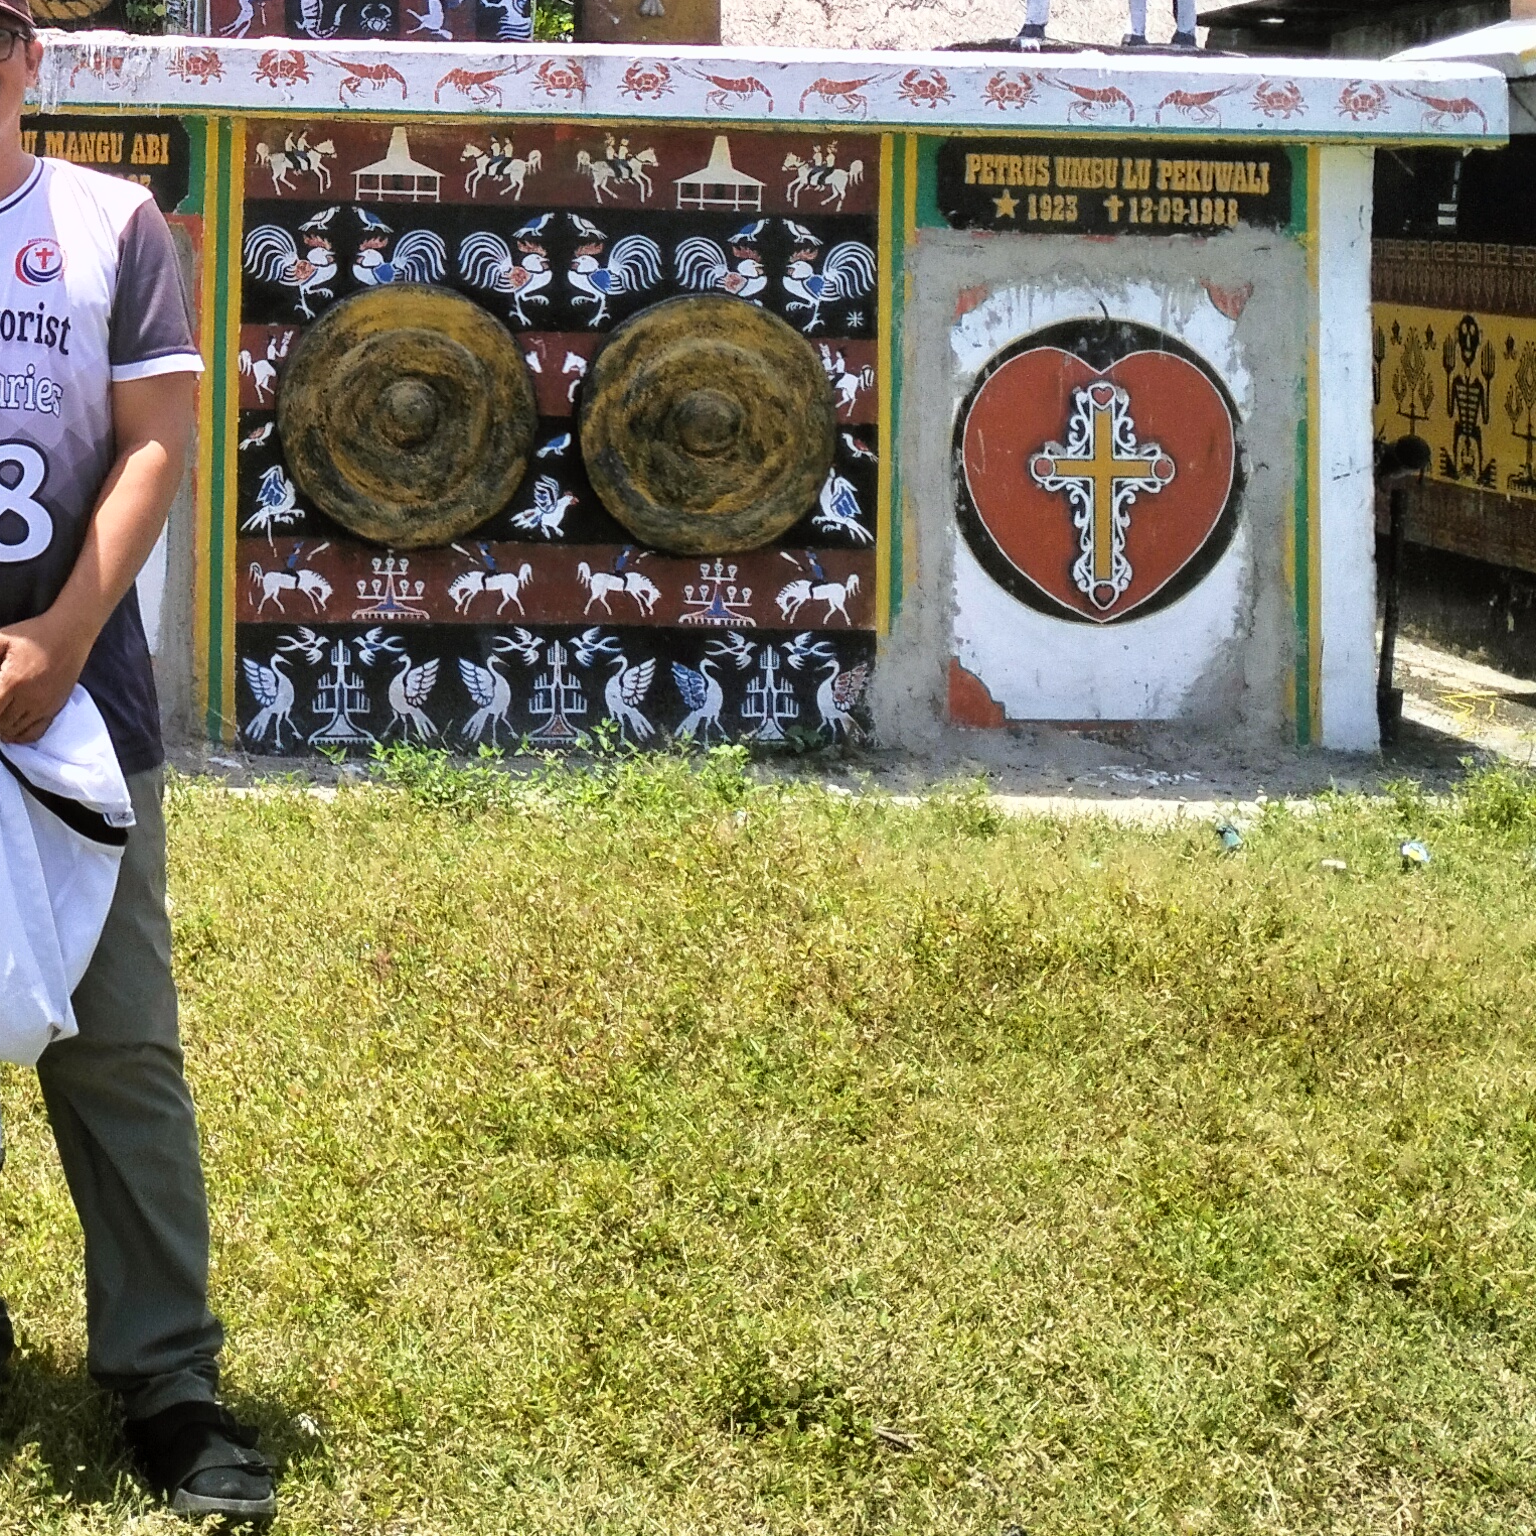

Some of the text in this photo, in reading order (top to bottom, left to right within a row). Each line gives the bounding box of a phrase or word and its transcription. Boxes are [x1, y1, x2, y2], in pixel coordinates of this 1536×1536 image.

[44, 131, 125, 163] MANGU
[130, 133, 170, 165] ABI
[964, 152, 1271, 196] PETRUS UMBU LU PEKUWALI
[1027, 193, 1079, 223] 1923
